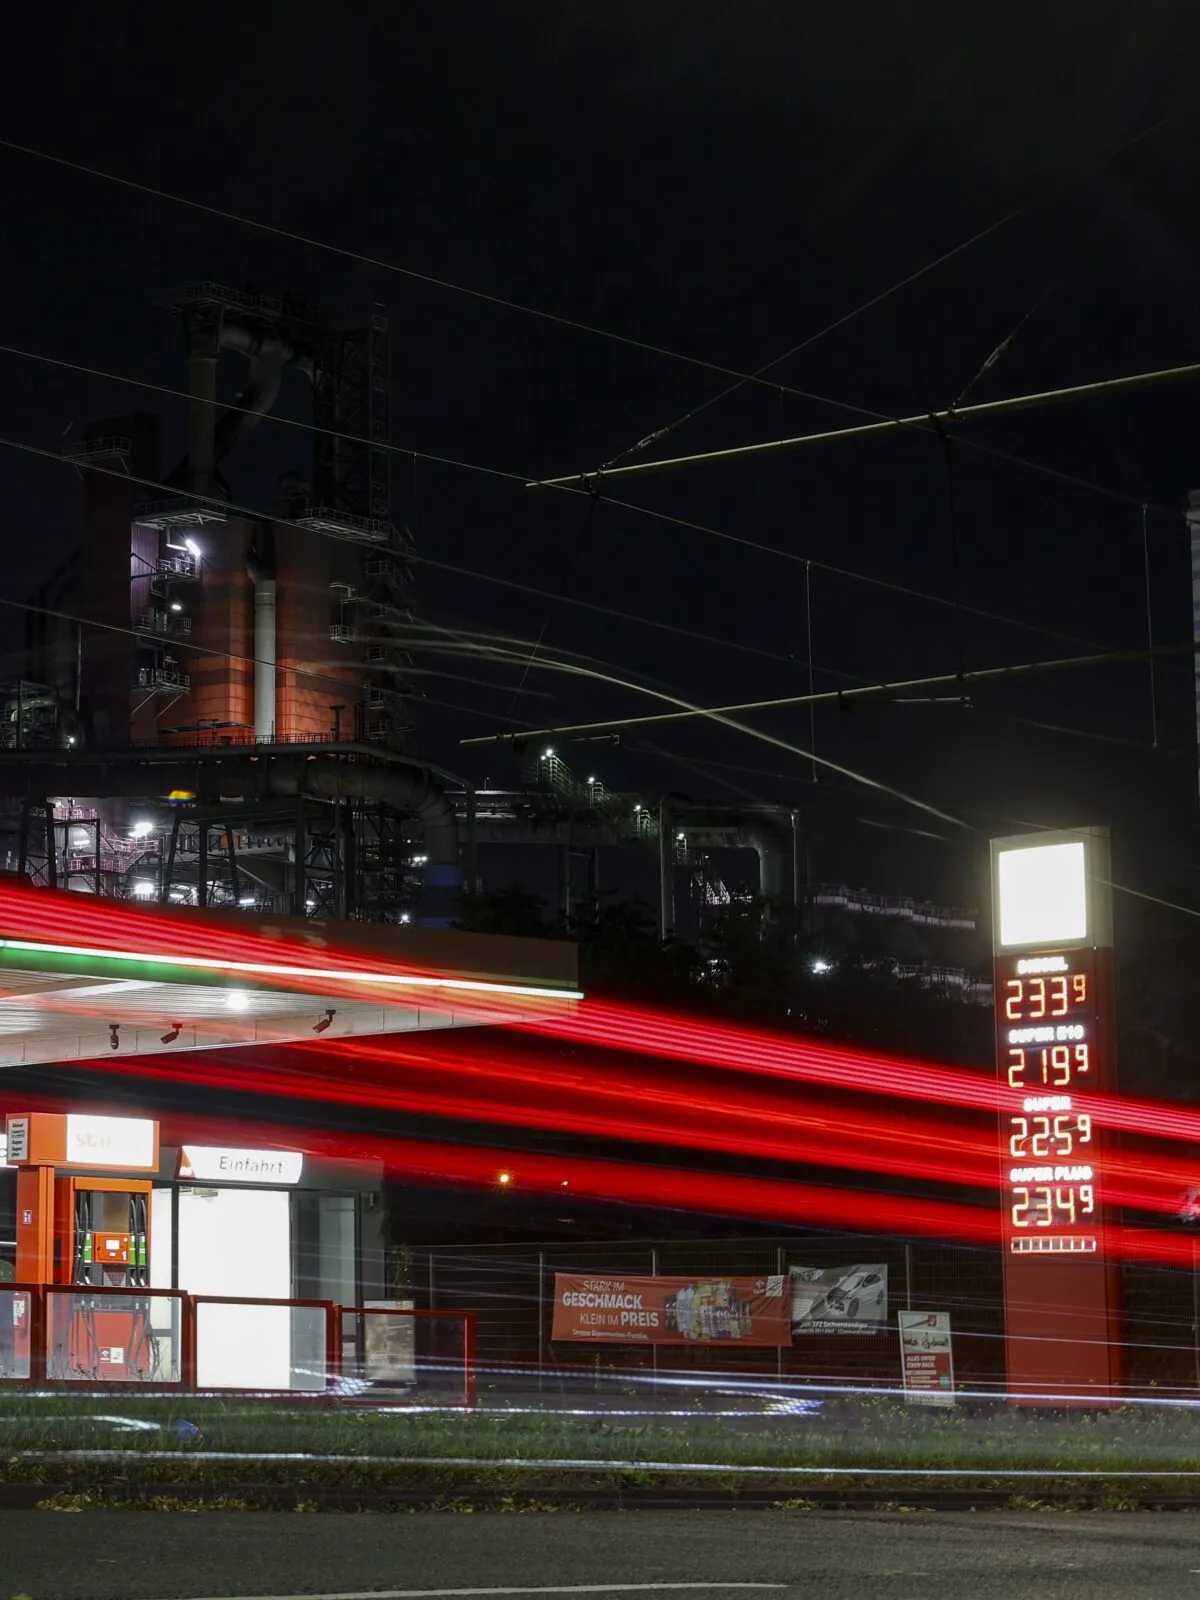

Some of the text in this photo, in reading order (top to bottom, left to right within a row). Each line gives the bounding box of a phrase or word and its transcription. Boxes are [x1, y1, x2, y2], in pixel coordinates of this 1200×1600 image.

[1008, 1027, 1054, 1044] SUPER
[1023, 1096, 1072, 1112] SUPER
[219, 1155, 283, 1174] Einfahrt
[1010, 1166, 1093, 1182] SUPER PLUS
[121, 1250, 127, 1260] 1
[583, 1280, 611, 1292] STARK
[562, 1292, 643, 1309] GESCHMACK
[580, 1311, 659, 1327] KLEIN IM PREIS
